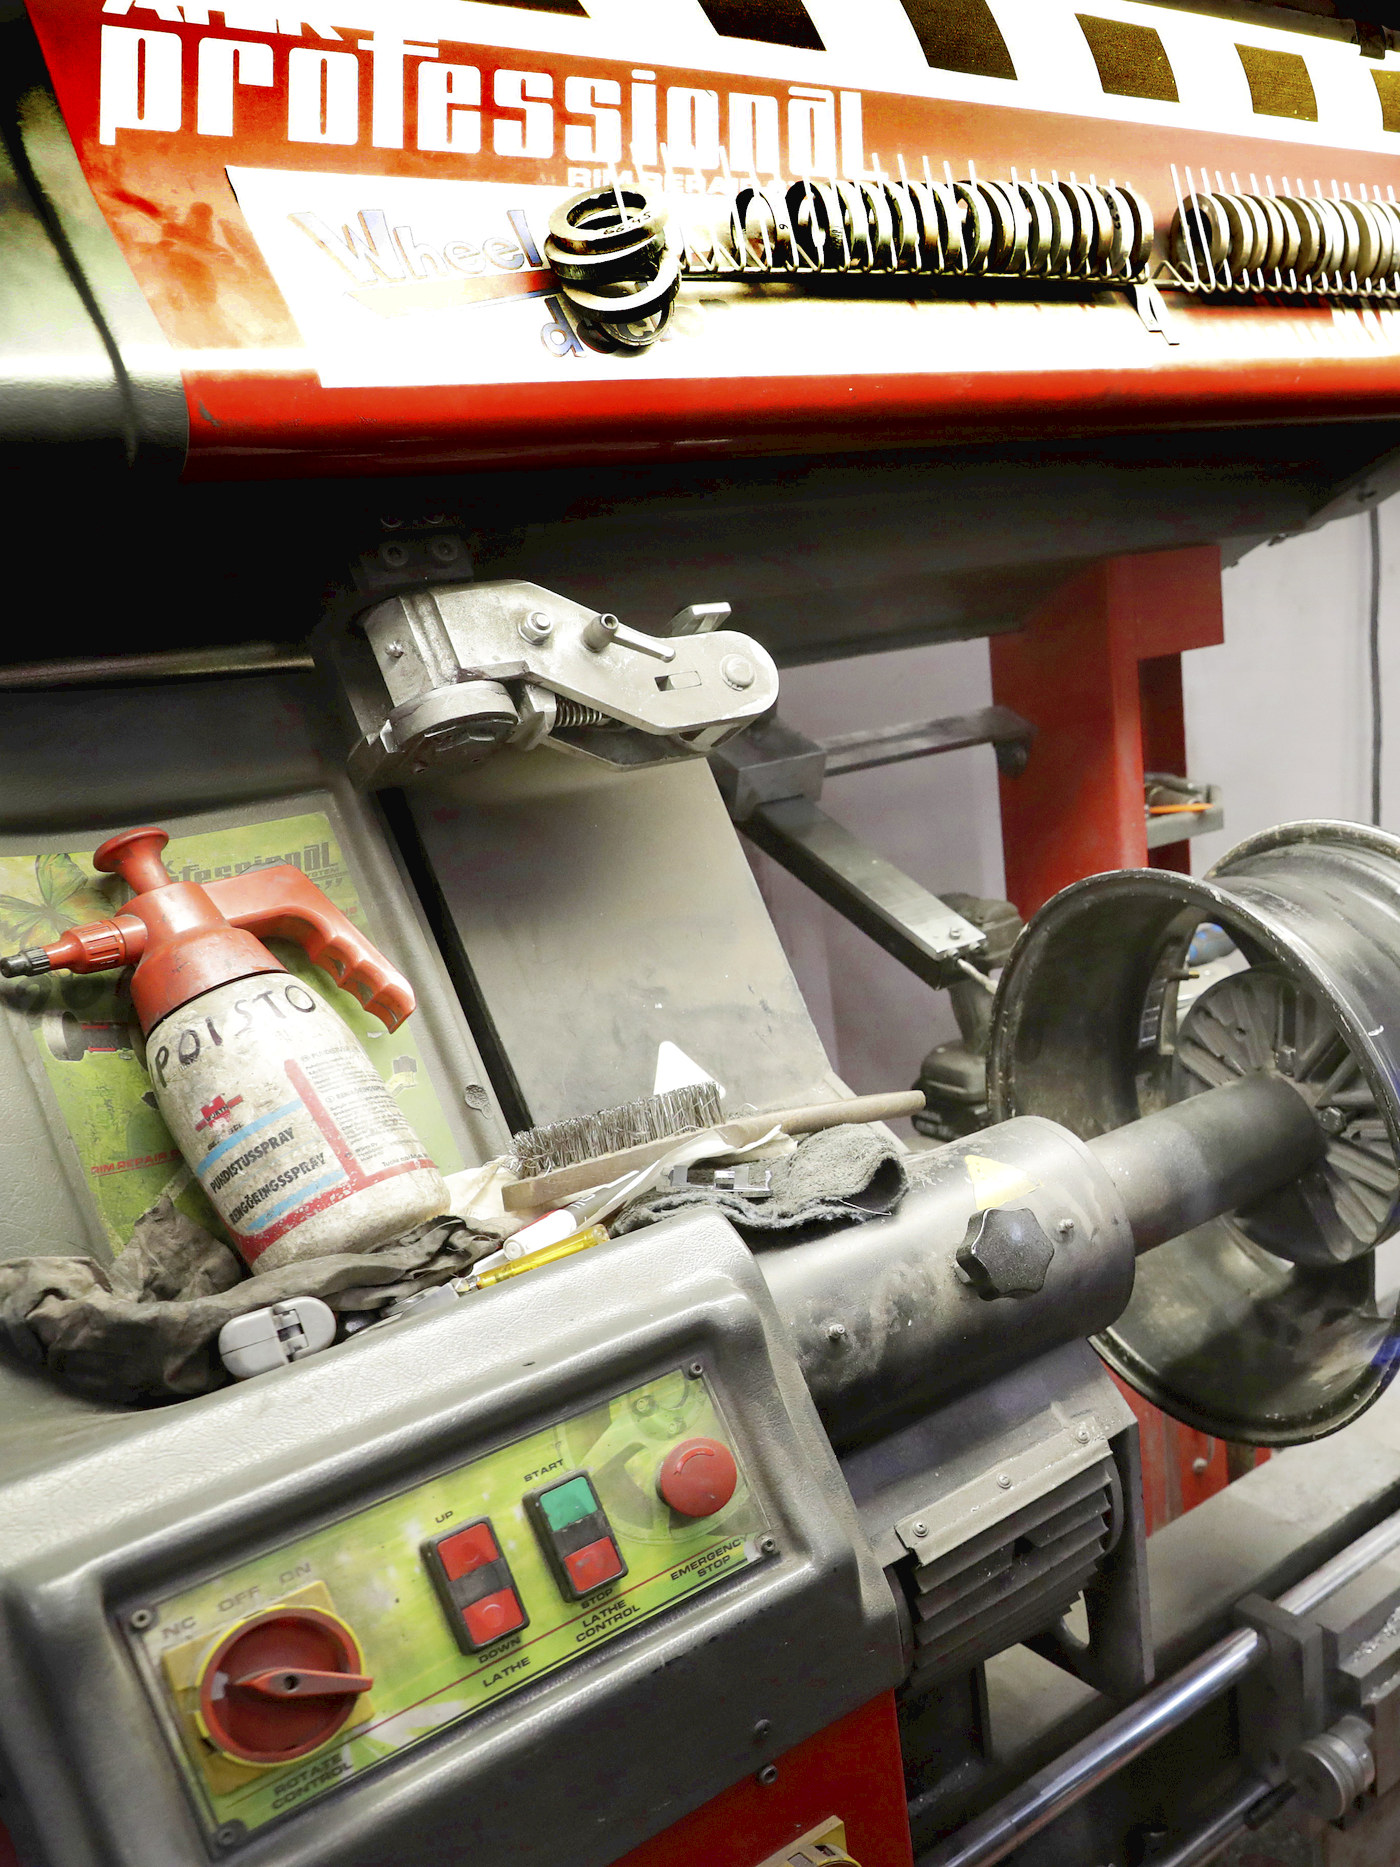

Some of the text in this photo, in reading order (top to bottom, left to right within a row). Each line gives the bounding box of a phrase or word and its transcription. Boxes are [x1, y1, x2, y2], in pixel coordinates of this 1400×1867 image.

[99, 24, 888, 181] professional
[287, 209, 544, 288] Wheel
[155, 984, 316, 1089] POISTO
[210, 1127, 295, 1194] PUHDISTUSSPRAY
[523, 1458, 564, 1482] START
[435, 1510, 454, 1523] UP
[697, 1554, 731, 1577] STOP
[216, 1585, 260, 1612] OFF
[581, 1588, 614, 1610] STOP
[576, 1605, 641, 1643] CONTROL
[582, 1600, 626, 1628] LATHE
[478, 1636, 521, 1664] DOWN
[482, 1657, 531, 1688] LATHE
[272, 1763, 354, 1809] CONTROL
